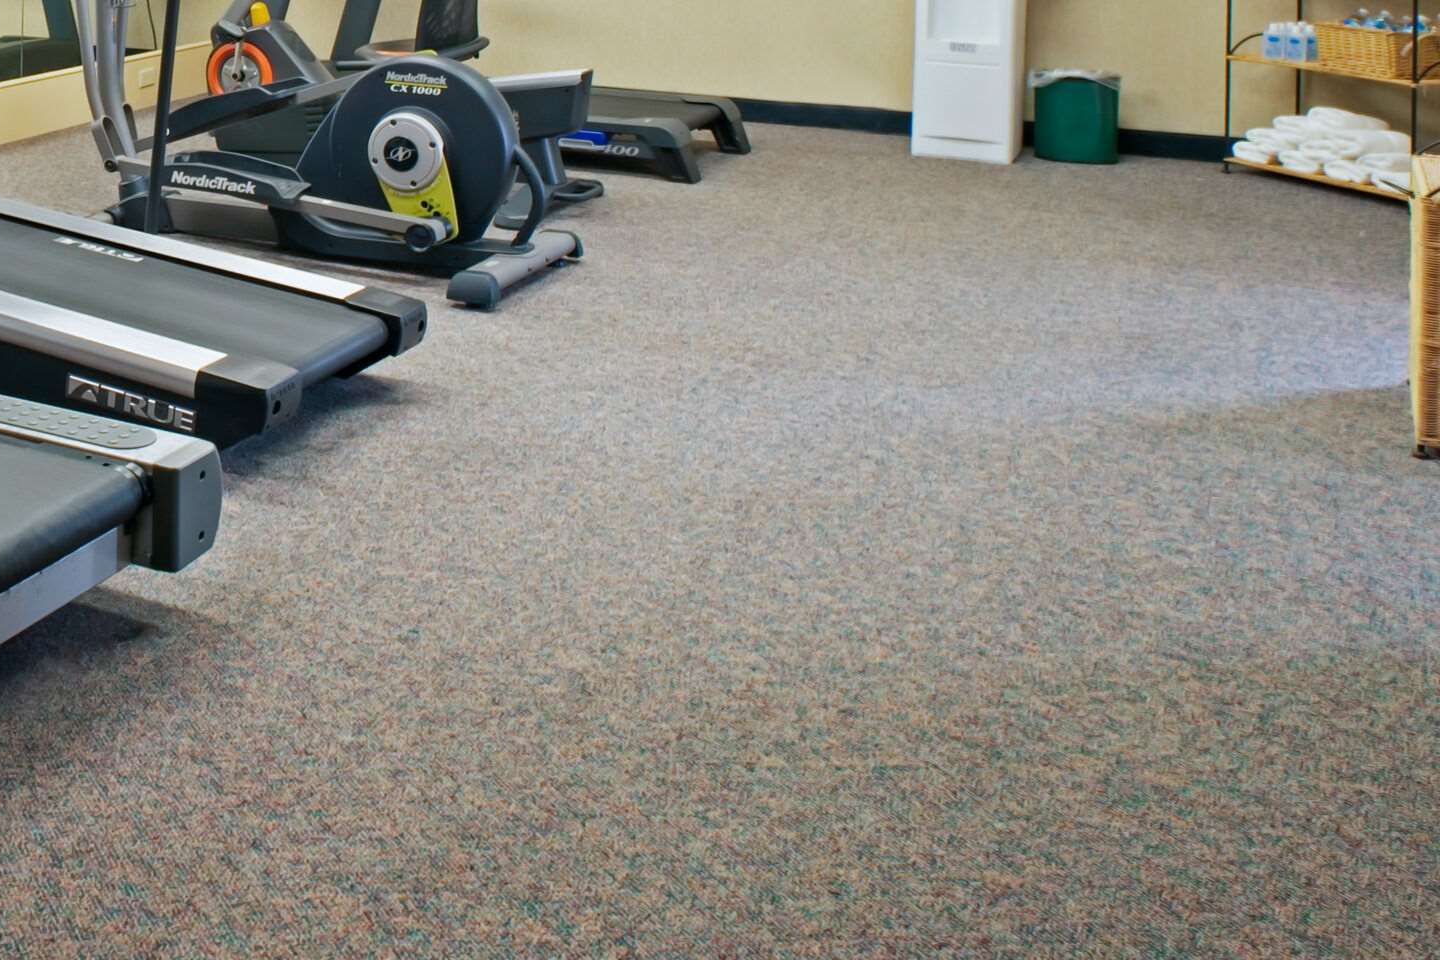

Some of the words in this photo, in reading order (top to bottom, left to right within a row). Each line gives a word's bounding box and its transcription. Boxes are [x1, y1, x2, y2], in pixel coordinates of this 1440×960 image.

[385, 71, 447, 85] NordicTrack
[390, 83, 409, 94] CX
[411, 84, 442, 96] 1000
[170, 169, 258, 195] NordicTrack
[99, 383, 197, 432] TRUE
